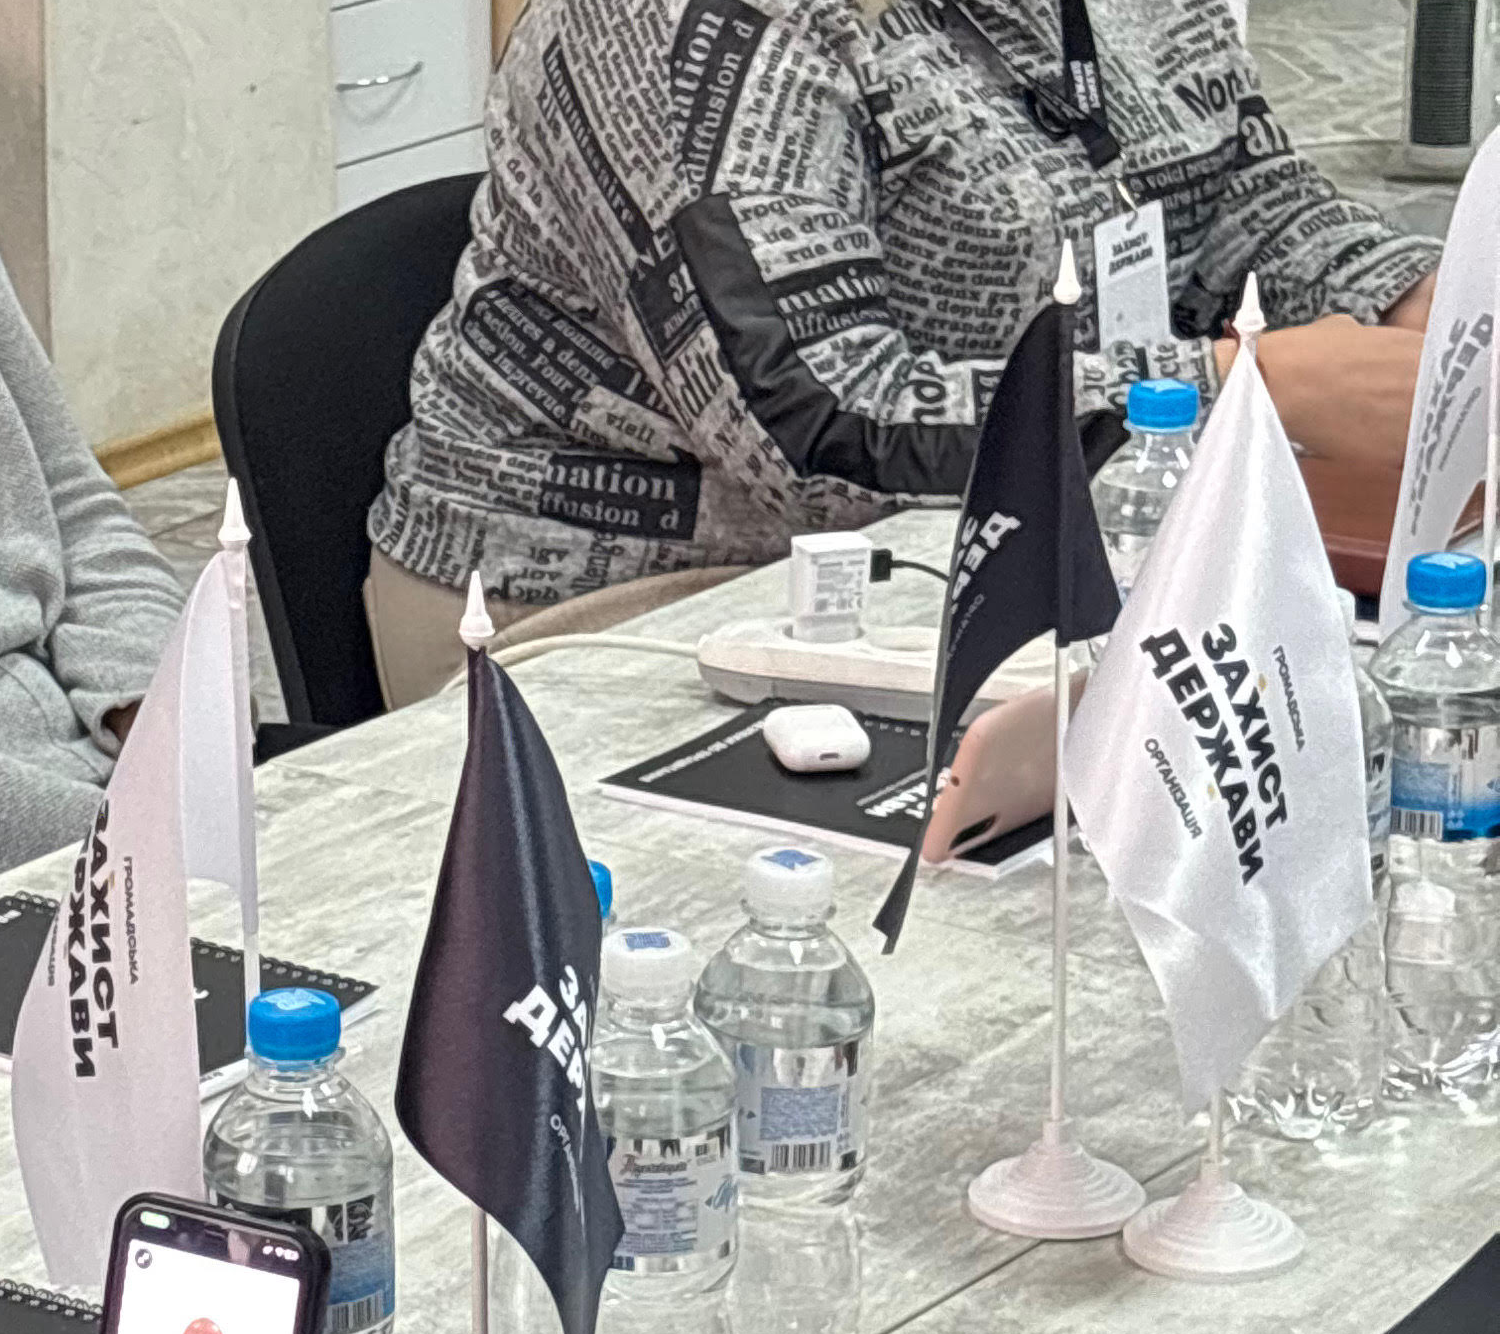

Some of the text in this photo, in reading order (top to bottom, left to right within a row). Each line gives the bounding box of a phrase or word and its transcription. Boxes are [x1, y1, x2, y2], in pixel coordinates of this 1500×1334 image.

[681, 49, 743, 181] diffusion
[1139, 627, 1265, 887] ДЕРЖАВИ
[1201, 622, 1288, 830] ЗАХИСТ
[1273, 646, 1305, 752] ГРОМАДСЬКА
[1142, 737, 1204, 842] ОРГАНІЗАЦІЯ
[68, 829, 97, 1078] РЖАВИ
[91, 797, 119, 1050] ЗАХИСТ
[123, 855, 138, 985] ГРОМАДСЬКА
